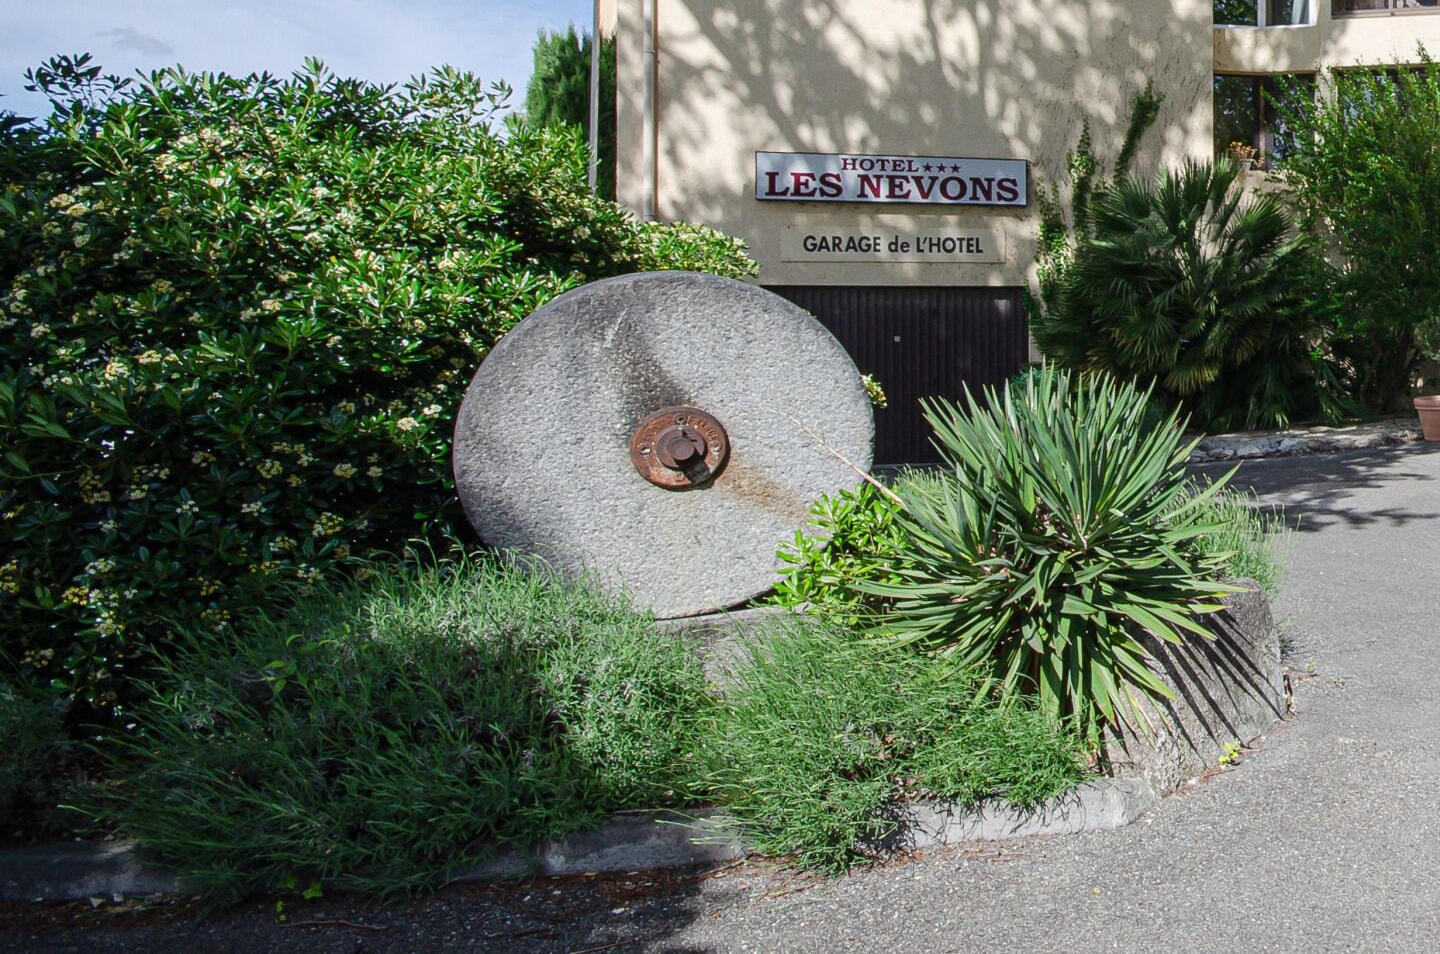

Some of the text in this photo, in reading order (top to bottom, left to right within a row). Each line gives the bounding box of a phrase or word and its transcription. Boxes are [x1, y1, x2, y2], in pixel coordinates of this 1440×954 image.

[841, 157, 920, 173] HOTEL
[765, 171, 1020, 202] LES NEVONS
[803, 234, 984, 254] GARAGE de L'HOTEL
